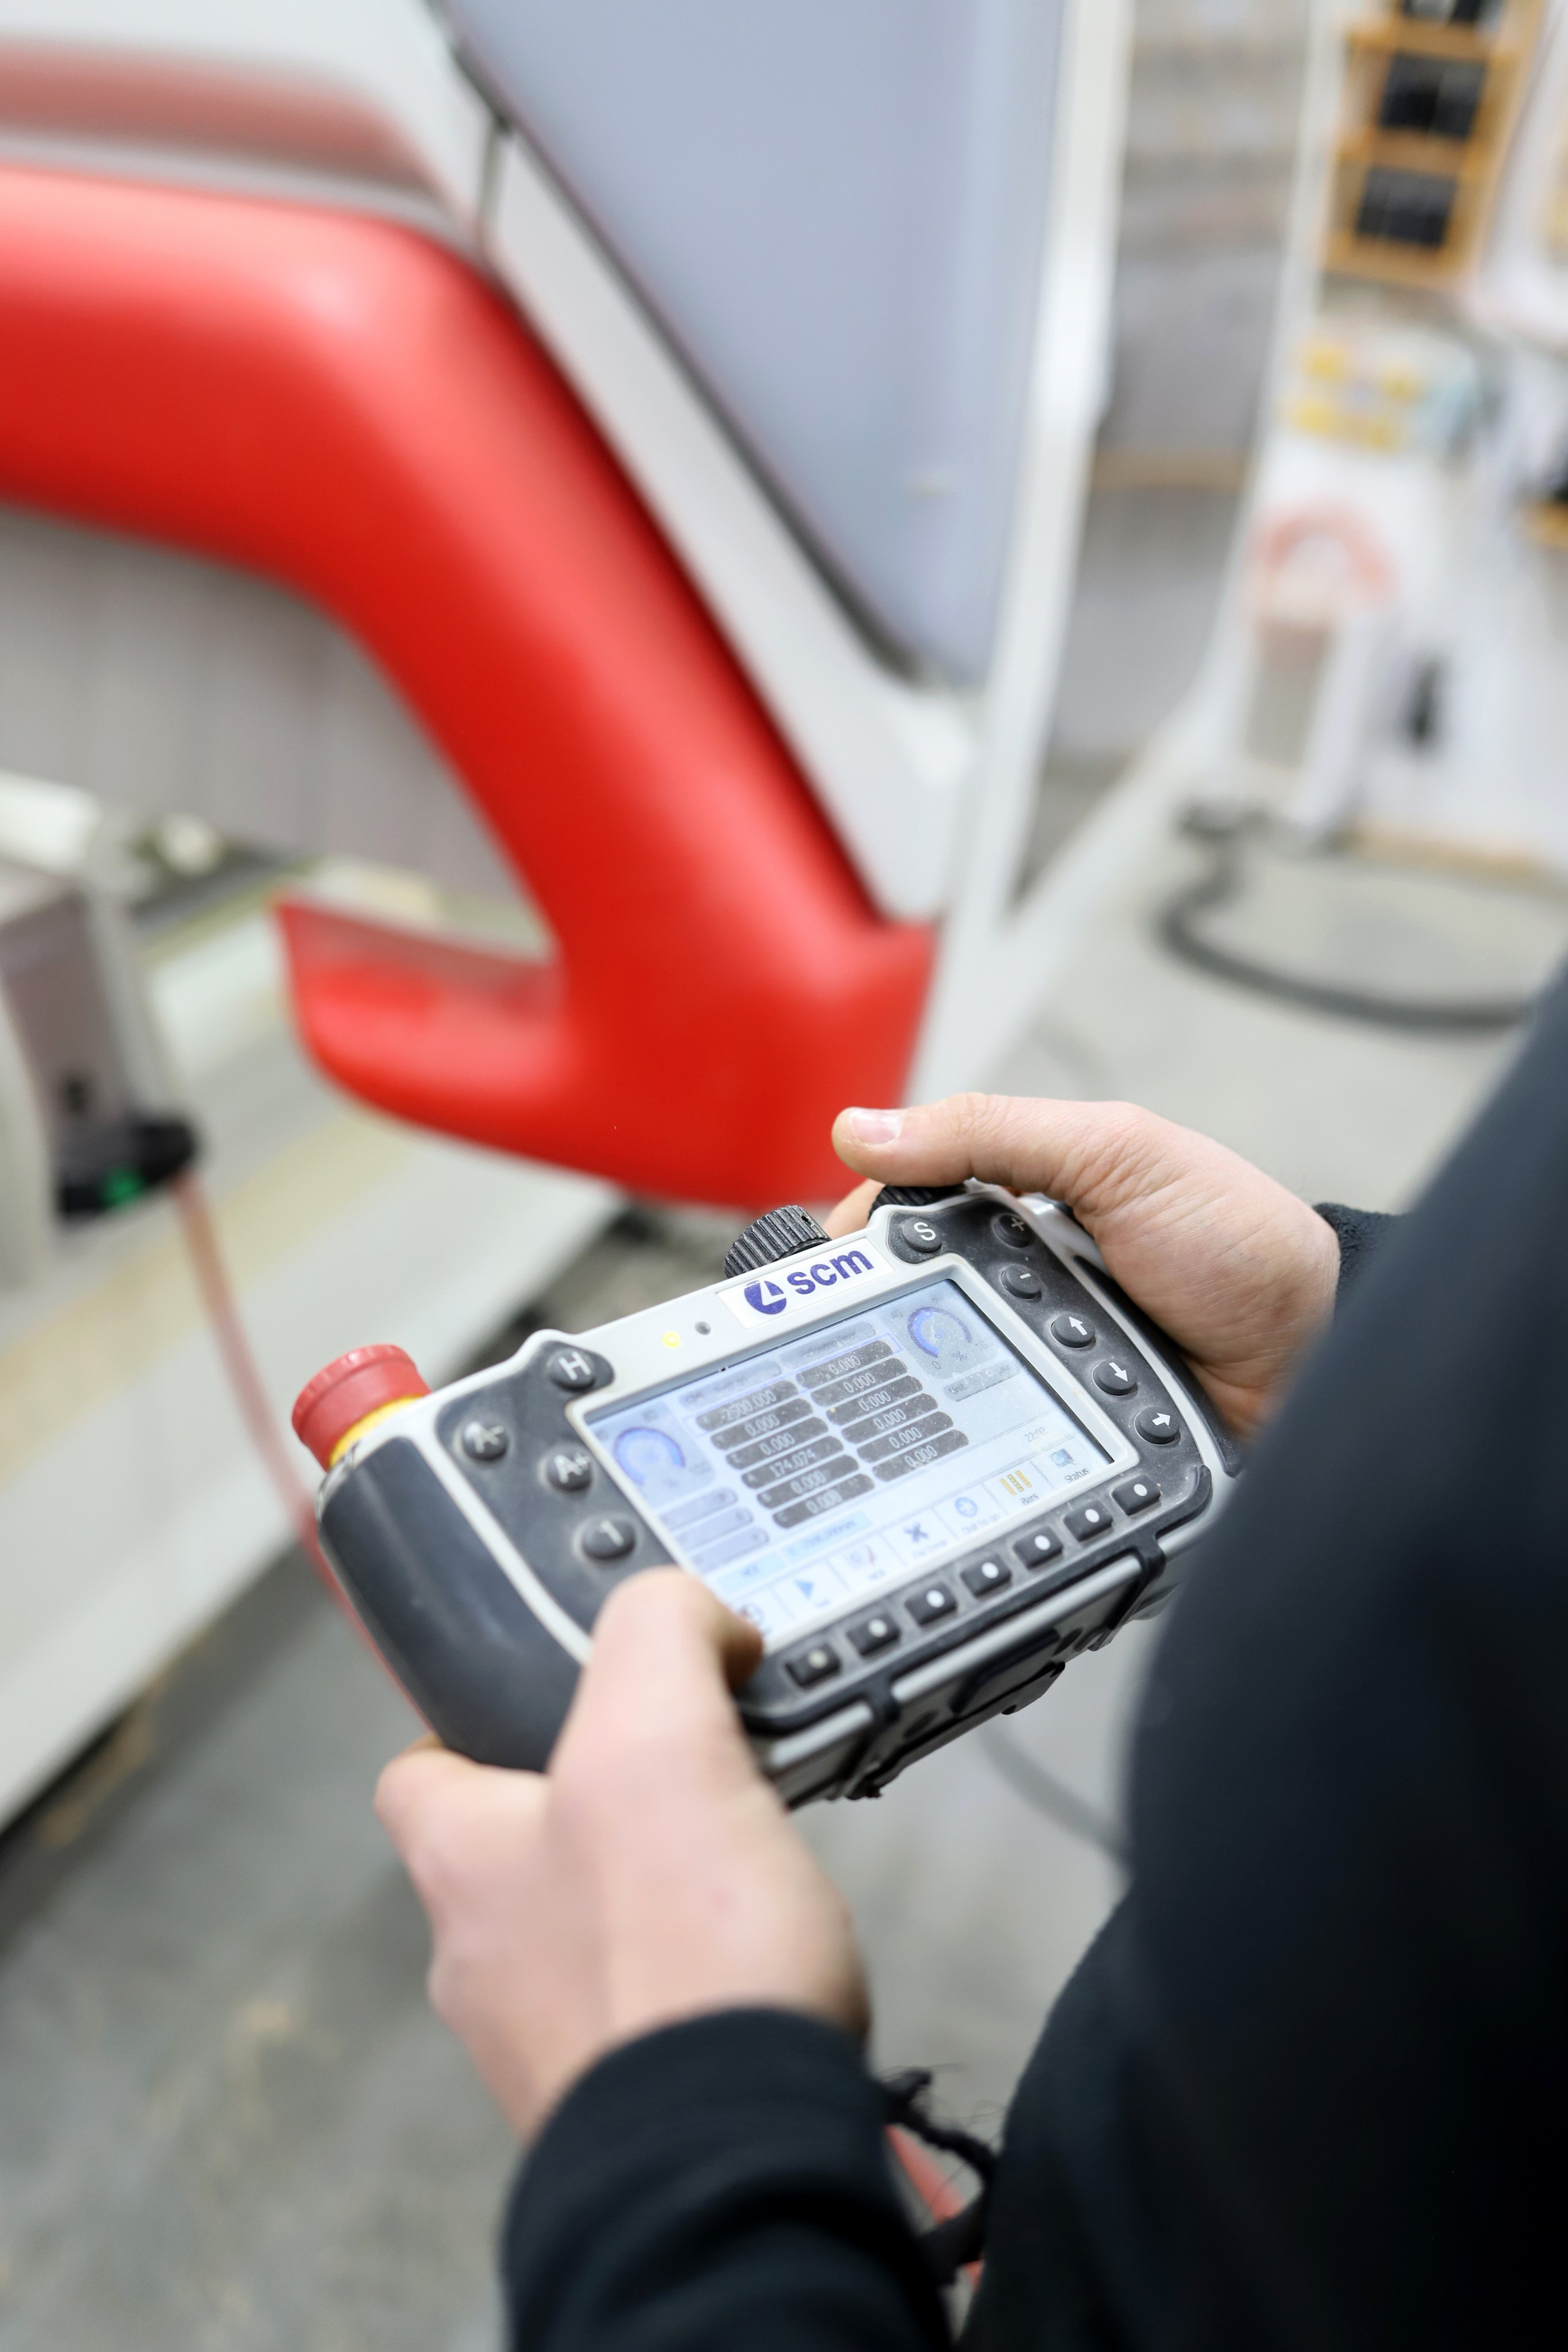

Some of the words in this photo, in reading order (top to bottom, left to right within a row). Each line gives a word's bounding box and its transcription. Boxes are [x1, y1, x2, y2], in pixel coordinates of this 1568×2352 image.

[913, 1222, 936, 1241] S
[787, 1250, 874, 1295] scm
[558, 1351, 591, 1380] H
[829, 1355, 861, 1375] 0.000
[932, 1360, 941, 1370] 0
[744, 1413, 780, 1438] 0.000
[843, 1373, 876, 1393] 0.000
[873, 1408, 906, 1430] 0.000
[758, 1432, 796, 1456] 0.000
[858, 1390, 891, 1412] 0.000
[554, 1452, 592, 1484] A+
[790, 1470, 827, 1495] 0.000
[889, 1427, 922, 1449] 0.000
[805, 1490, 842, 1515] 0.000
[904, 1445, 937, 1467] 0.000
[1065, 1467, 1089, 1484] Status
[1020, 1493, 1039, 1506] Bars
[600, 1520, 624, 1547] 1
